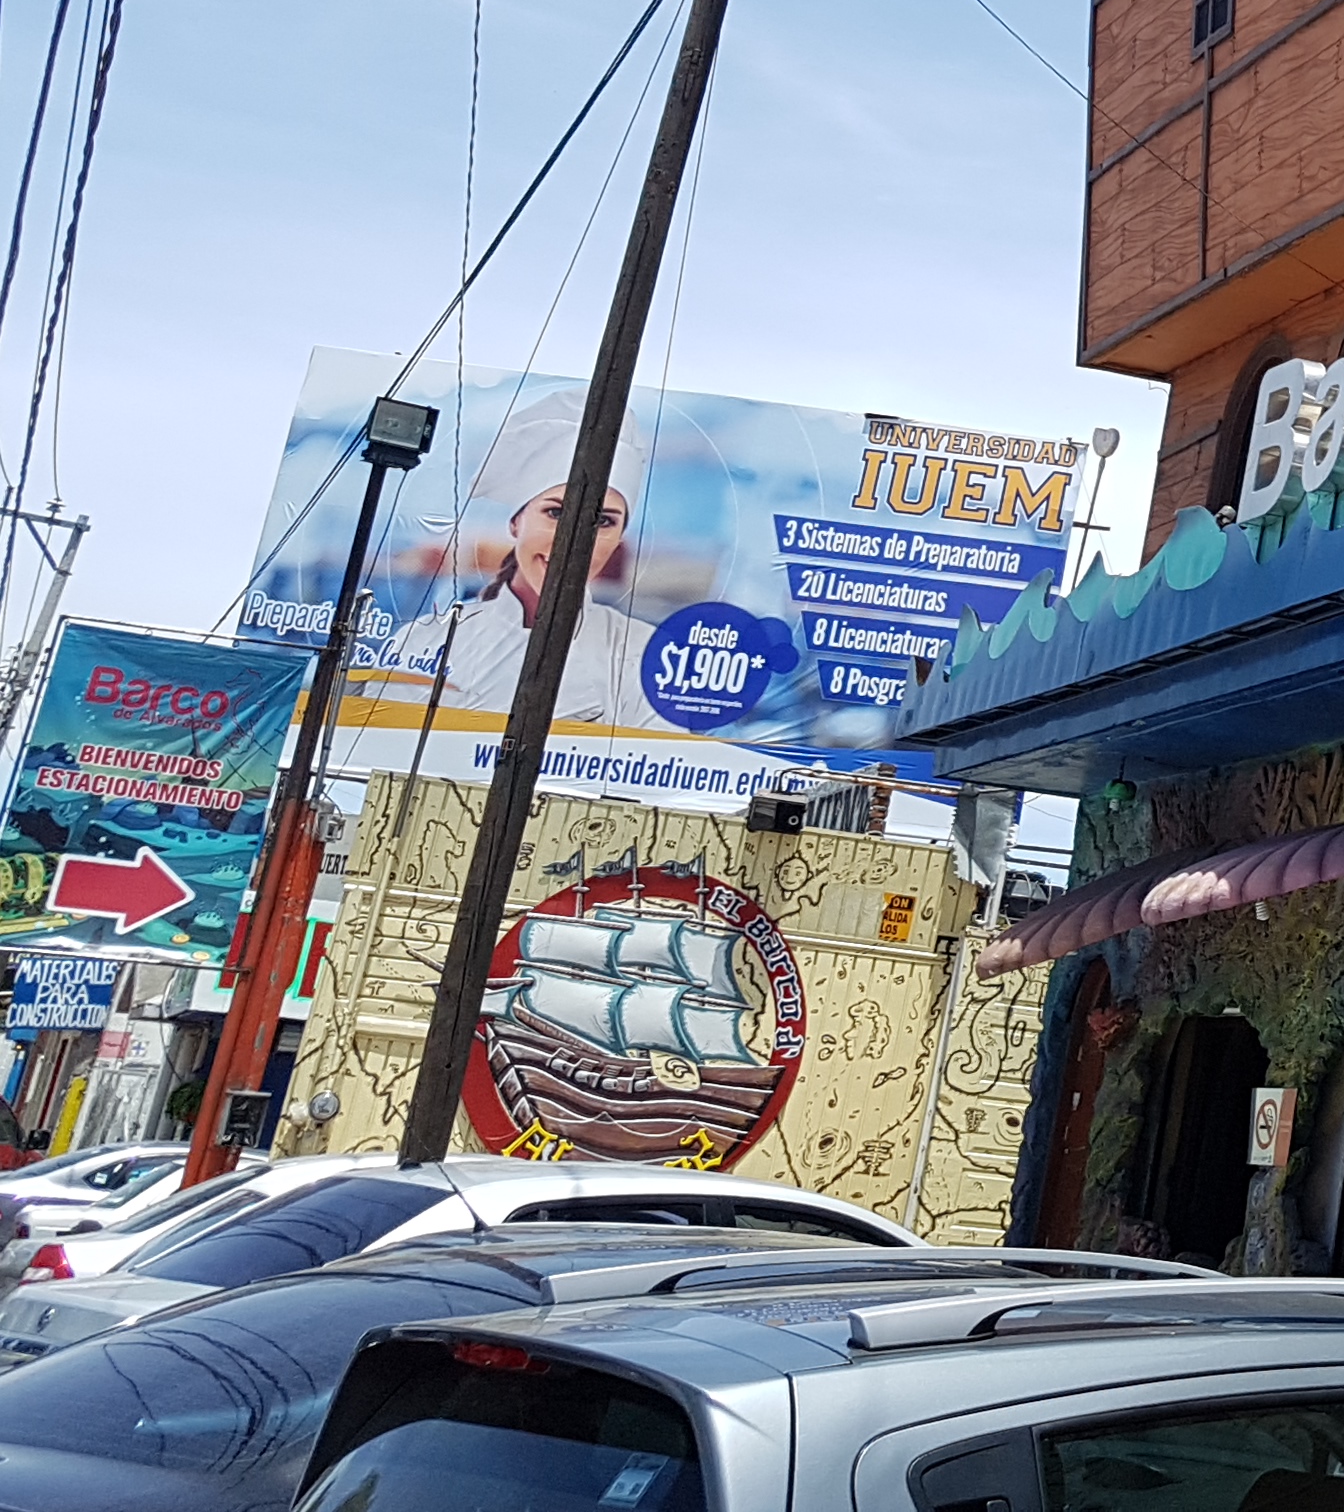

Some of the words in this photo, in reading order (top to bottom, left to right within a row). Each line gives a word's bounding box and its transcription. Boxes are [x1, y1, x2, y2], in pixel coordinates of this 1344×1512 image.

[867, 420, 1078, 468] UNIVERSIDAD
[851, 448, 1073, 533] IUEM
[782, 520, 797, 547] 3
[798, 522, 881, 564] Sistemas
[884, 533, 906, 561] de
[908, 535, 1021, 574] Preparatoria
[797, 569, 824, 598] 20
[825, 571, 948, 613] Licenciaturas
[688, 620, 739, 649] desde
[812, 618, 828, 646] 8
[379, 638, 403, 668] la
[84, 664, 230, 719] Barco
[830, 666, 845, 694] 8
[845, 667, 907, 706] Posgra
[113, 708, 133, 720] de
[78, 743, 223, 781] BIENVENIDOS
[36, 767, 243, 811] ESTACIONAMIENTO
[14, 959, 118, 985] MATERIALES
[35, 983, 89, 1005] PARA
